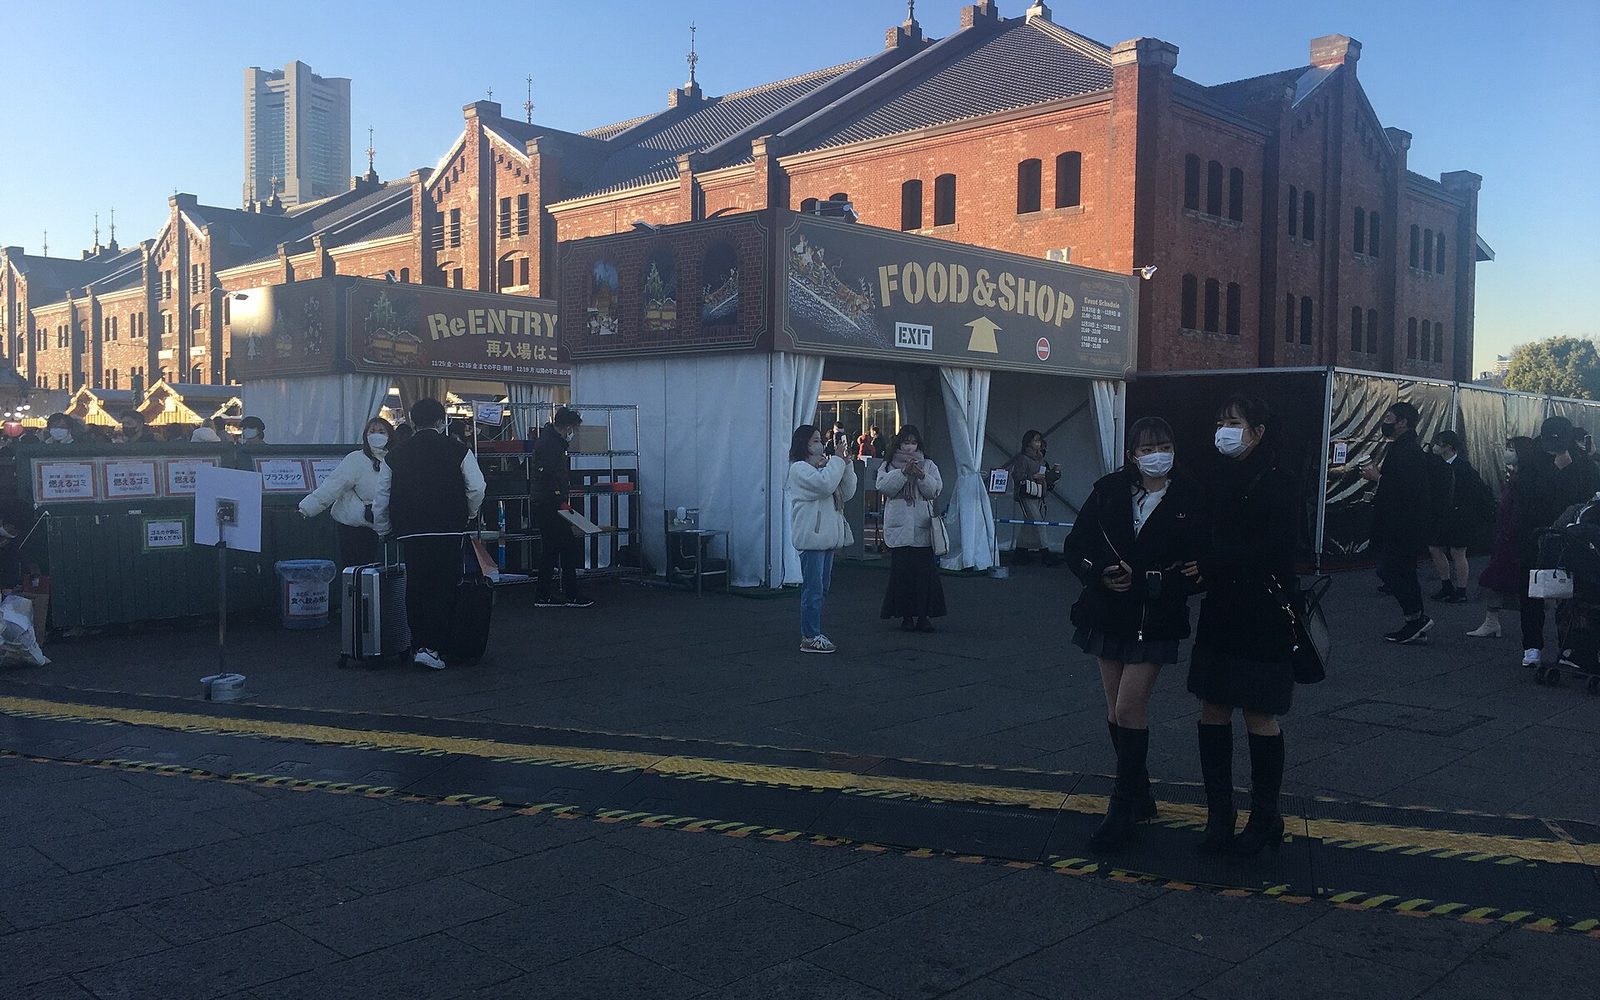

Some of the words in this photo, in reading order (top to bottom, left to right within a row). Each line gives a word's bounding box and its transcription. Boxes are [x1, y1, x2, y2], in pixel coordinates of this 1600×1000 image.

[427, 308, 558, 341] ReENTRY
[898, 325, 931, 346] EXIT
[48, 479, 88, 488] 燃えるゴミ
[113, 477, 150, 486] 燃えるゴミ
